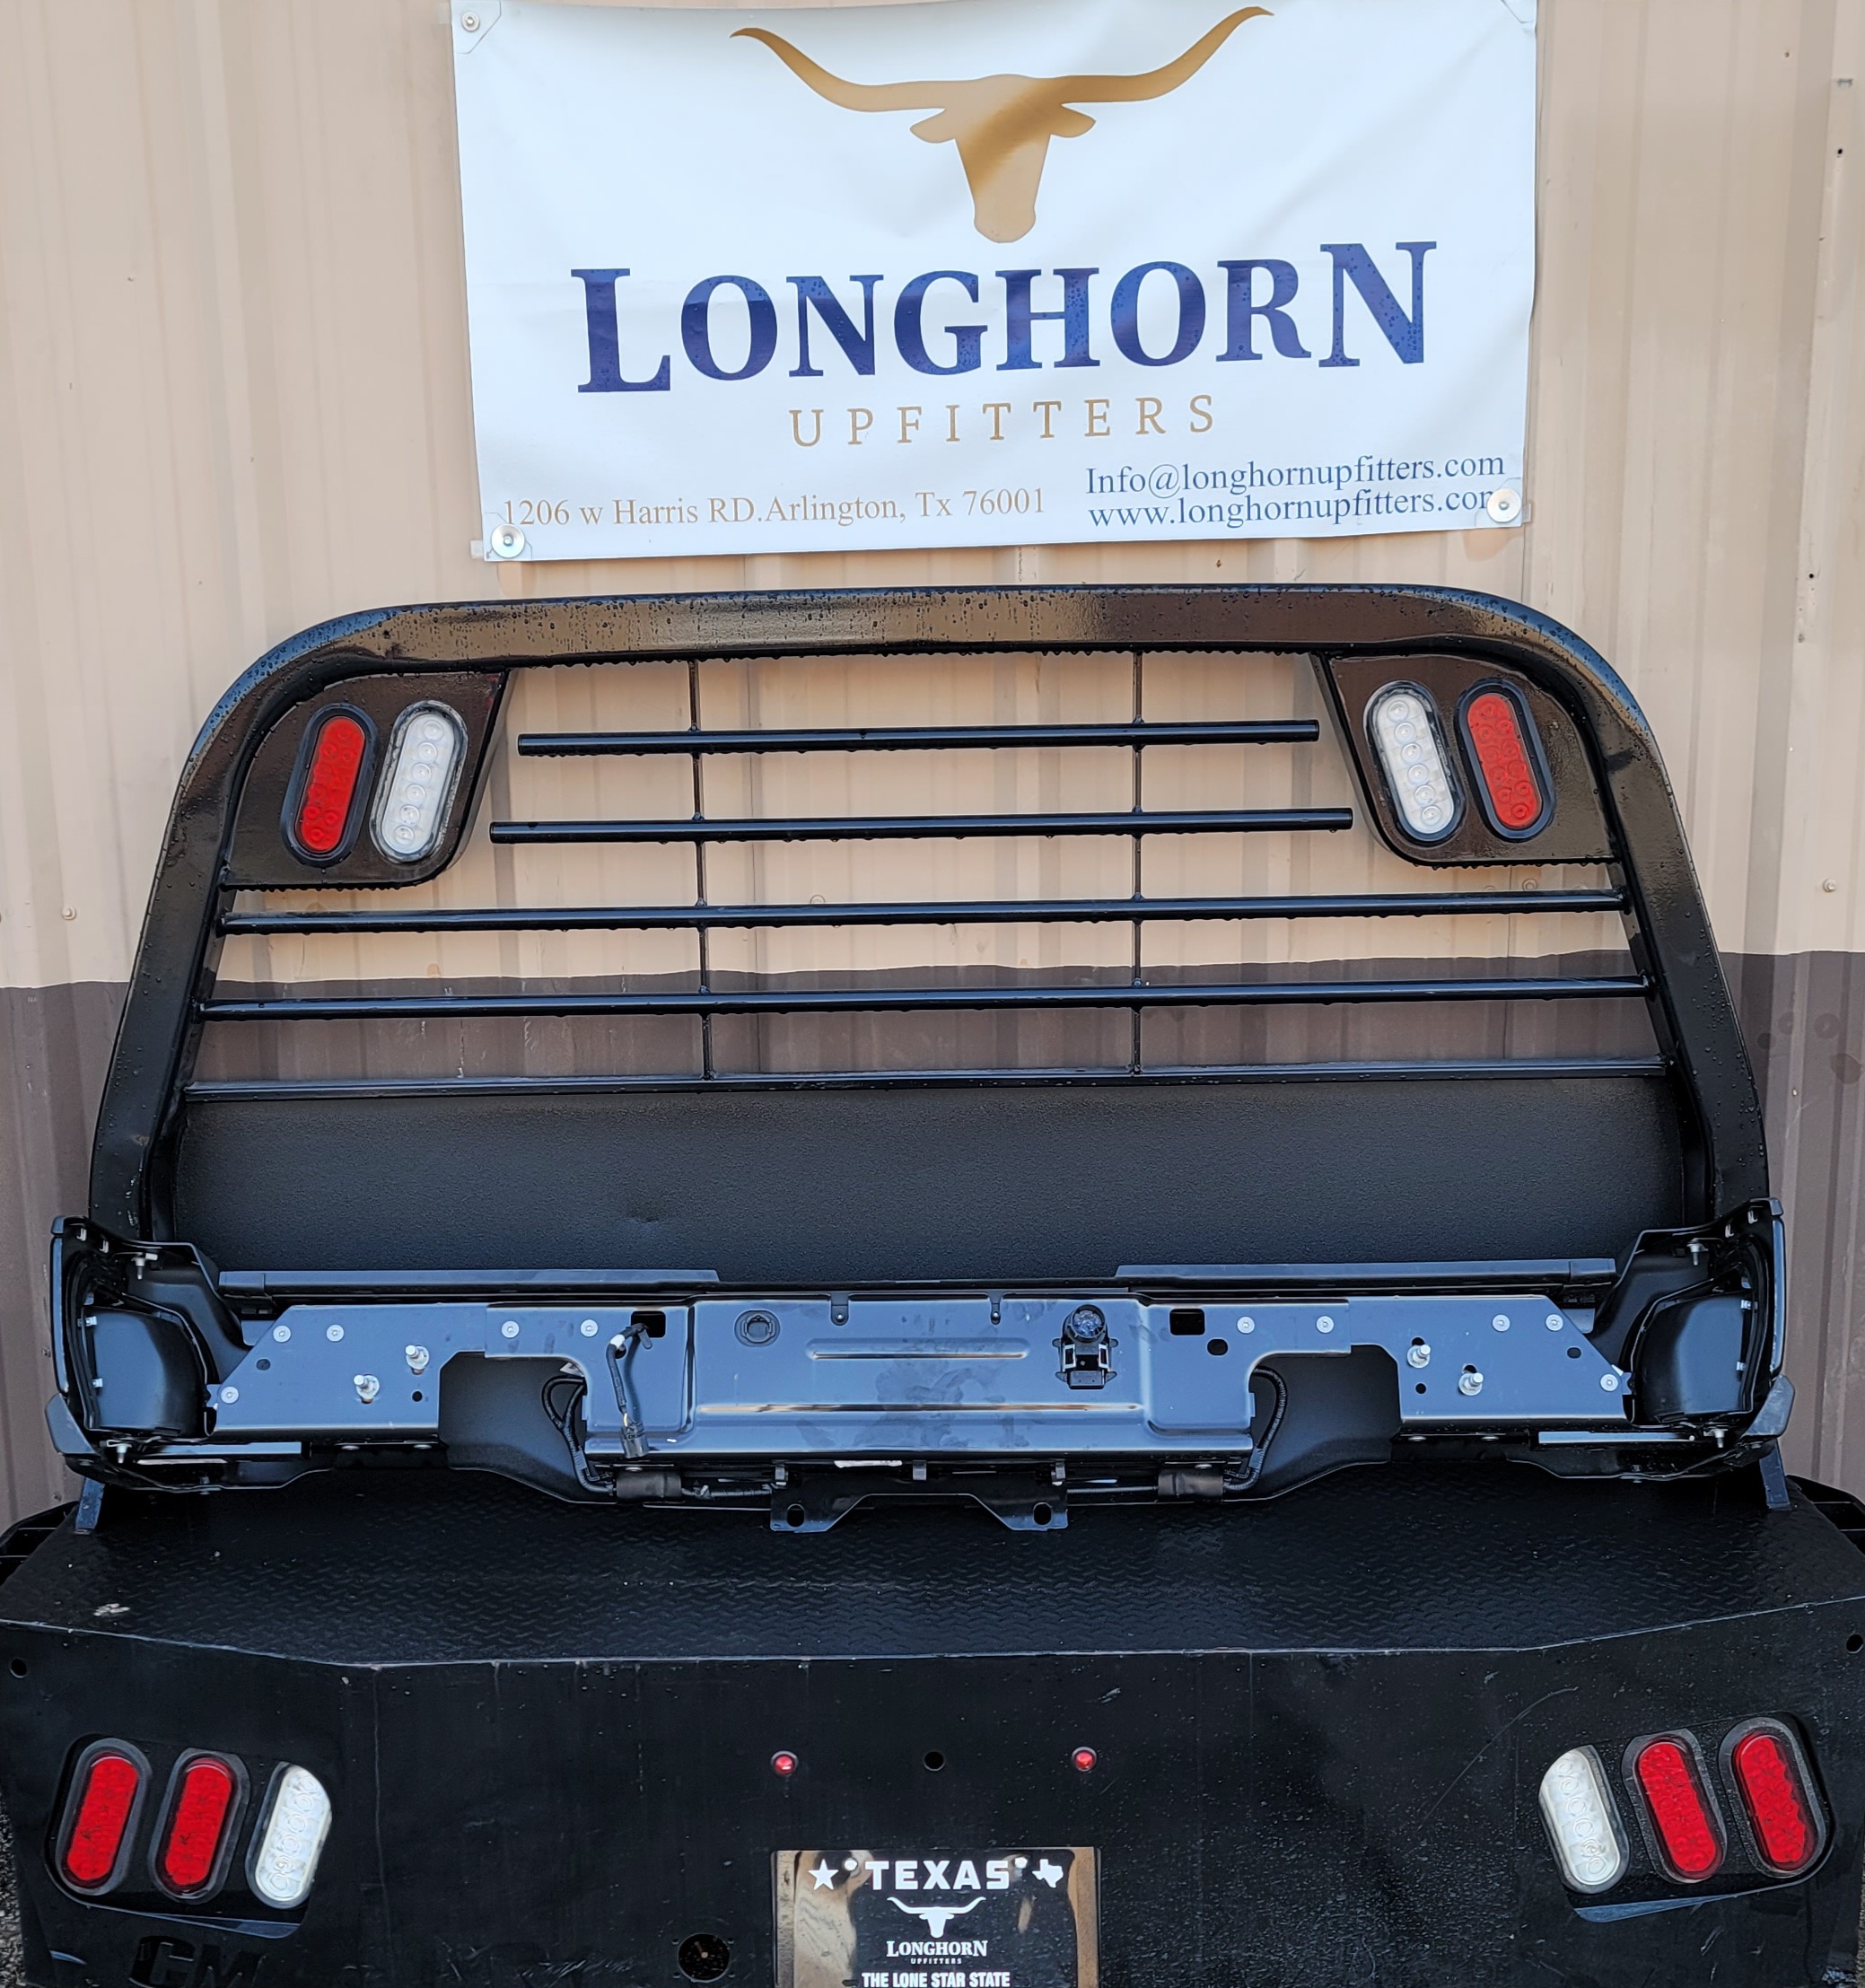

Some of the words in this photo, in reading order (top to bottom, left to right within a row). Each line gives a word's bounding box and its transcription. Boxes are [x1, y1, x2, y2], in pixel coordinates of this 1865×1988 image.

[570, 241, 1437, 393] LONGHORN
[788, 395, 1215, 448] UPFITTERS
[1085, 455, 1505, 499] Info@longhornupfitters.com
[503, 498, 571, 526] 1206
[579, 505, 603, 525] w
[612, 497, 698, 524] Harris
[915, 491, 953, 517] Tx
[961, 486, 1046, 517] 76001
[864, 1860, 1011, 1891] TEXAS
[886, 1940, 989, 1957] LONGHORN
[862, 1972, 889, 1988] THE
[892, 1972, 928, 1988] LONE
[931, 1972, 966, 1988] STAR
[969, 1971, 1011, 1988] STATE
